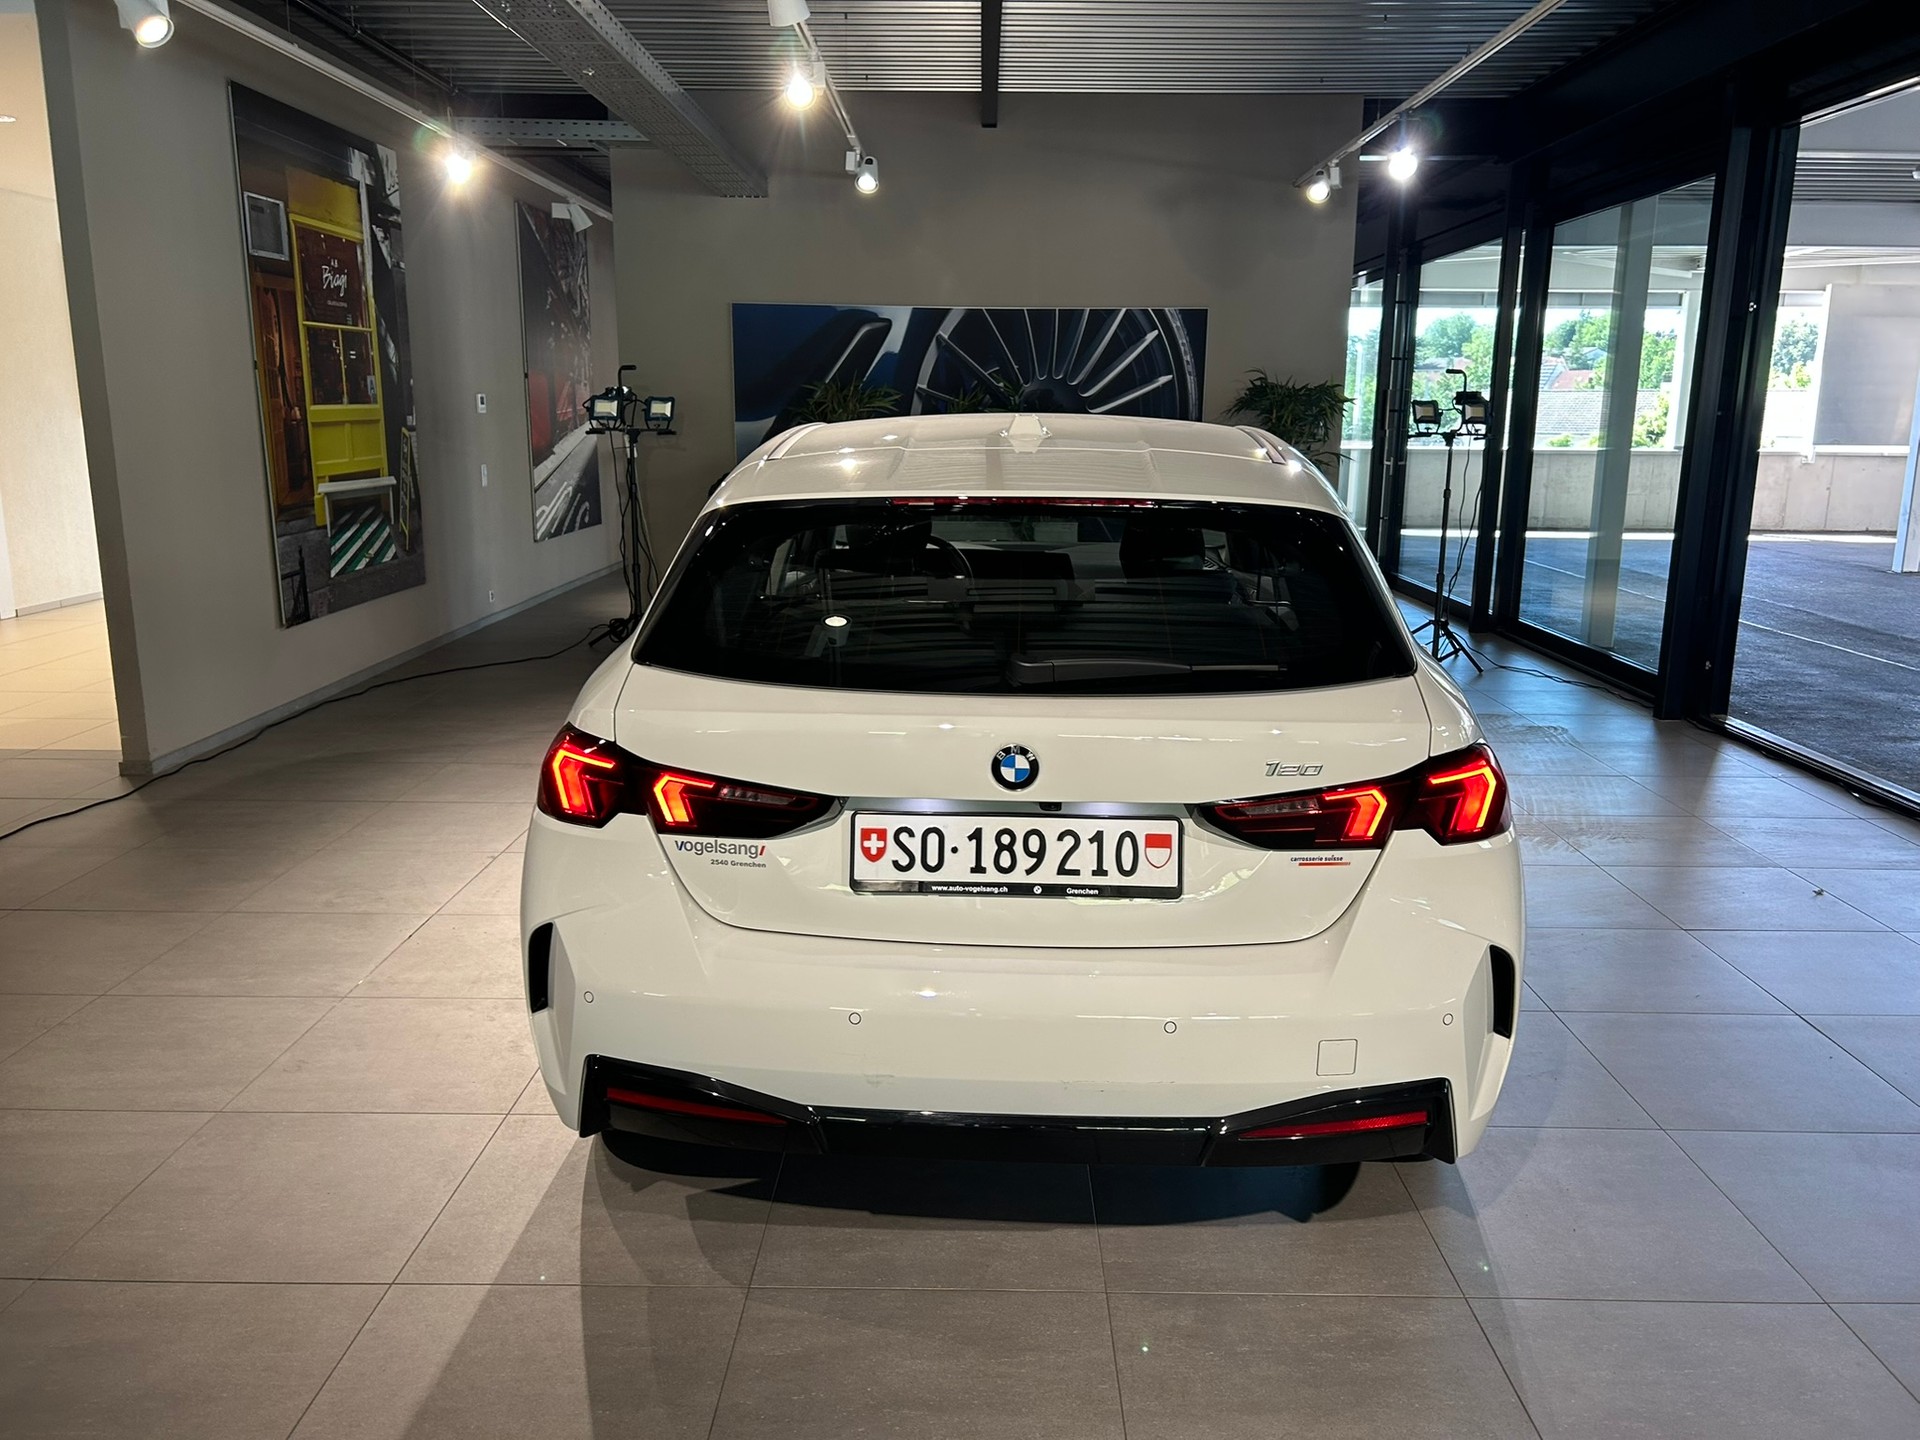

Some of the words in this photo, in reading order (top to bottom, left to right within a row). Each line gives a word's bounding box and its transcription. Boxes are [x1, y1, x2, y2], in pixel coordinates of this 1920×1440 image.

[321, 265, 348, 297] Biagi
[995, 745, 1036, 761] BMW
[1265, 760, 1324, 777] 120
[730, 860, 767, 868] Grenchen
[931, 884, 1009, 894] www.auto-vogelsang.ch
[1066, 886, 1099, 895] Grenchen
